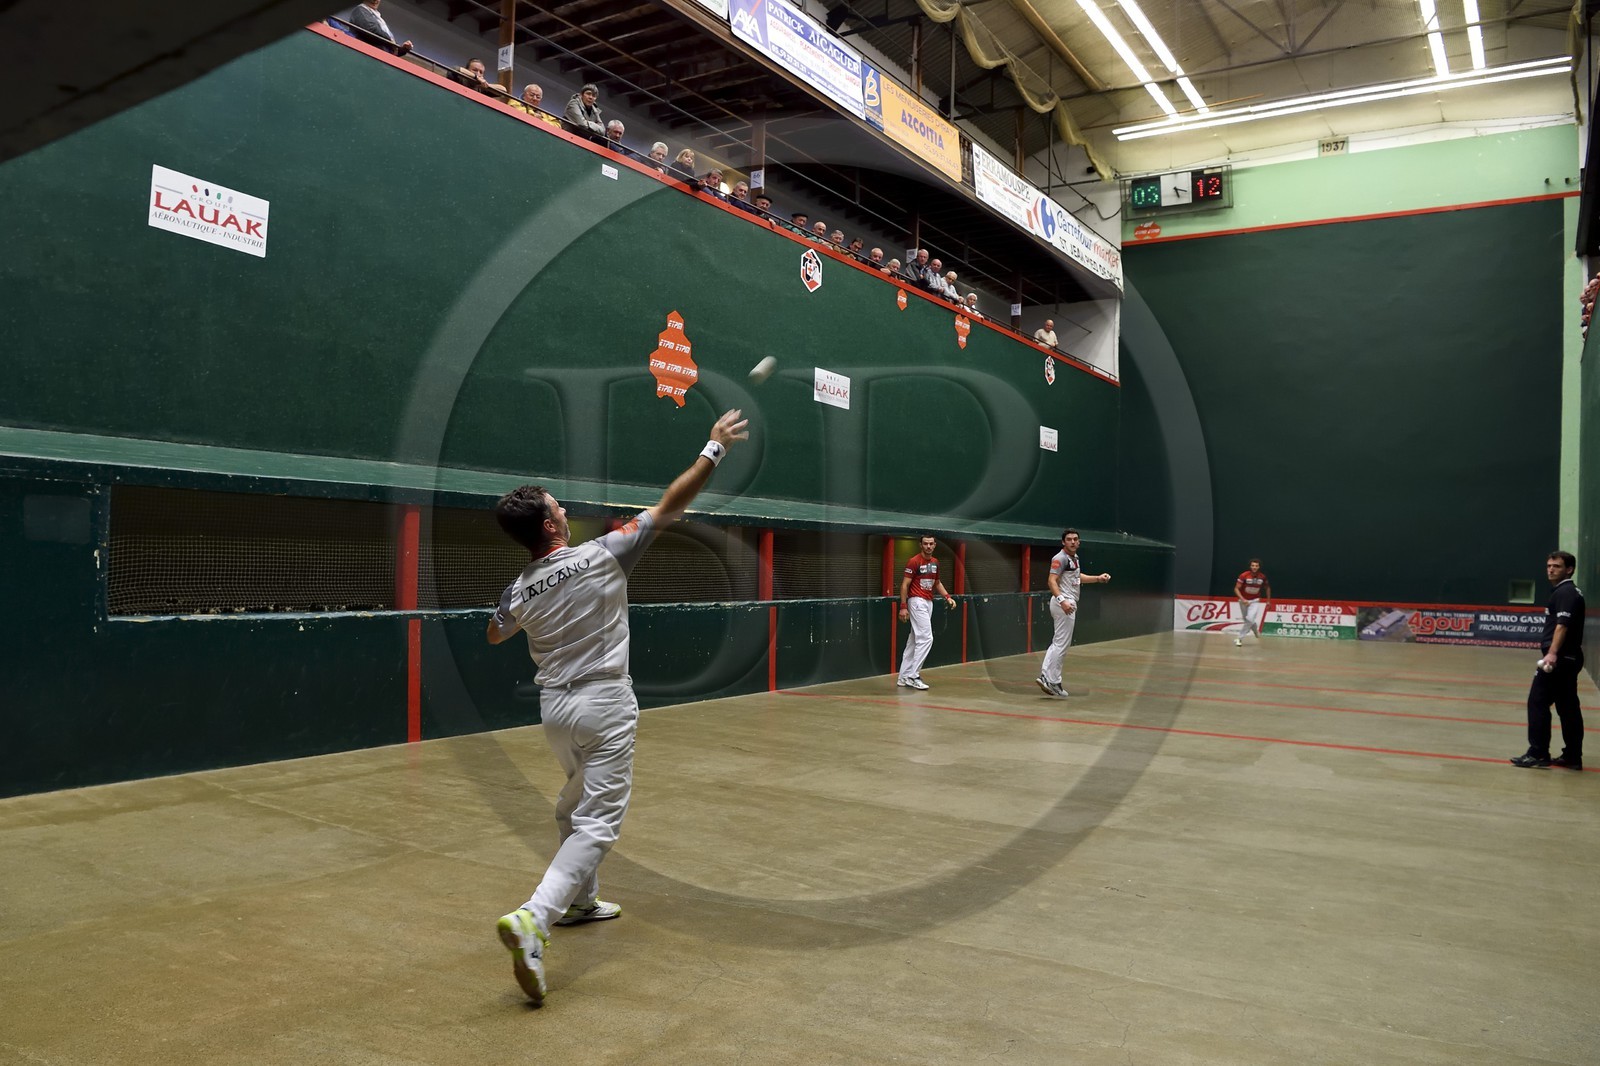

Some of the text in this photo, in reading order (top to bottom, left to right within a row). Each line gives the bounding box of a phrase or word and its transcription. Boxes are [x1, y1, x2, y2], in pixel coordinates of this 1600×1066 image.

[732, 8, 763, 44] AXA
[768, 2, 807, 35] PATRICK
[883, 82, 894, 95] LES
[901, 109, 944, 150] AZCOITIA
[1322, 140, 1345, 152] 1937
[1134, 185, 1159, 205] 03
[1197, 177, 1220, 197] 12
[190, 194, 235, 212] GROUPE
[154, 190, 264, 239] LAUAK
[152, 211, 217, 235] AÉRONAUTIQUE
[223, 231, 264, 249] INDUSTRIE
[1056, 210, 1092, 250] Carrefour
[1093, 242, 1119, 270] market
[816, 382, 848, 399] LAUAK
[521, 558, 590, 604] LAZCANO
[1186, 600, 1231, 622] CBA
[1275, 604, 1343, 614] NEUF ET RÉNO
[1291, 614, 1341, 624] GARAZI
[1479, 614, 1518, 623] IRATIKO
[1479, 624, 1528, 633] FROMAGERIE
